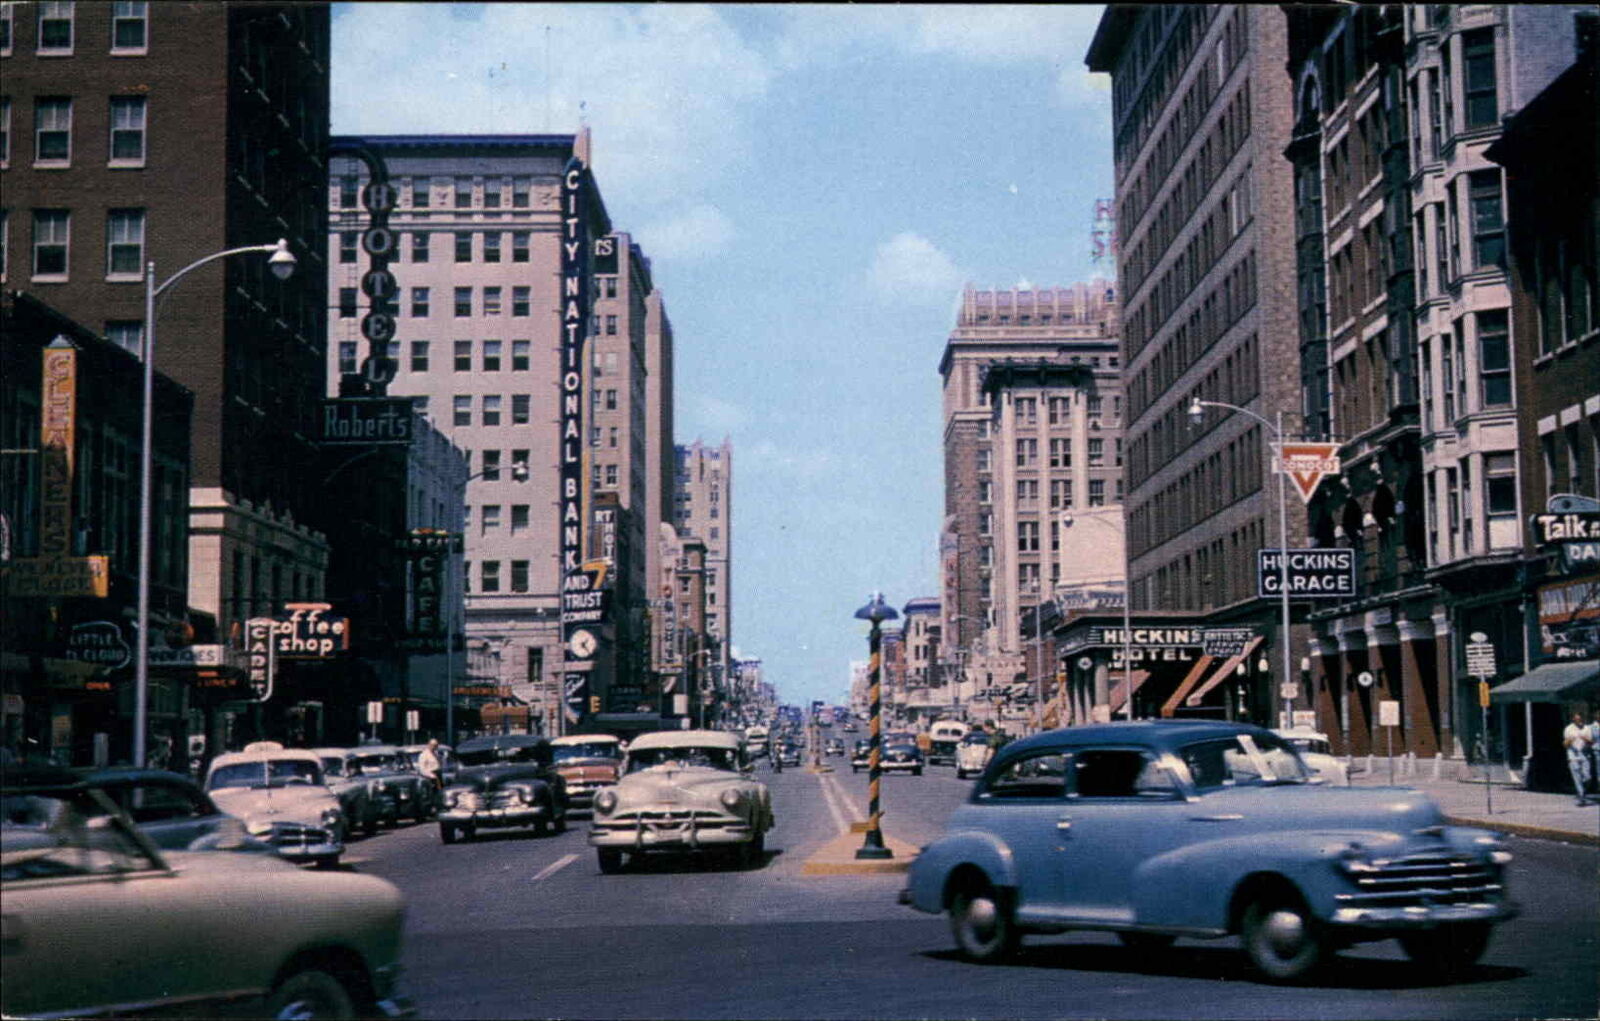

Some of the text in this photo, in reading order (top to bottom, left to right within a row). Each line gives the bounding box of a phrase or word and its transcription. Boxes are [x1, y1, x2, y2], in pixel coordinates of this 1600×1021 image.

[365, 184, 392, 383] HOTEL
[564, 169, 580, 571] CITY NATIONAL BANK
[1537, 513, 1589, 542] Talk
[1568, 544, 1600, 561] DA
[1262, 553, 1351, 571] HUCKINS
[564, 574, 590, 591] AND
[1264, 574, 1350, 592] GARAGE
[564, 591, 603, 609] TRUST
[279, 635, 334, 657] shop
[1103, 629, 1202, 645] HUCKINS
[250, 625, 267, 697] CADET
[1112, 648, 1193, 662] HOTEL
